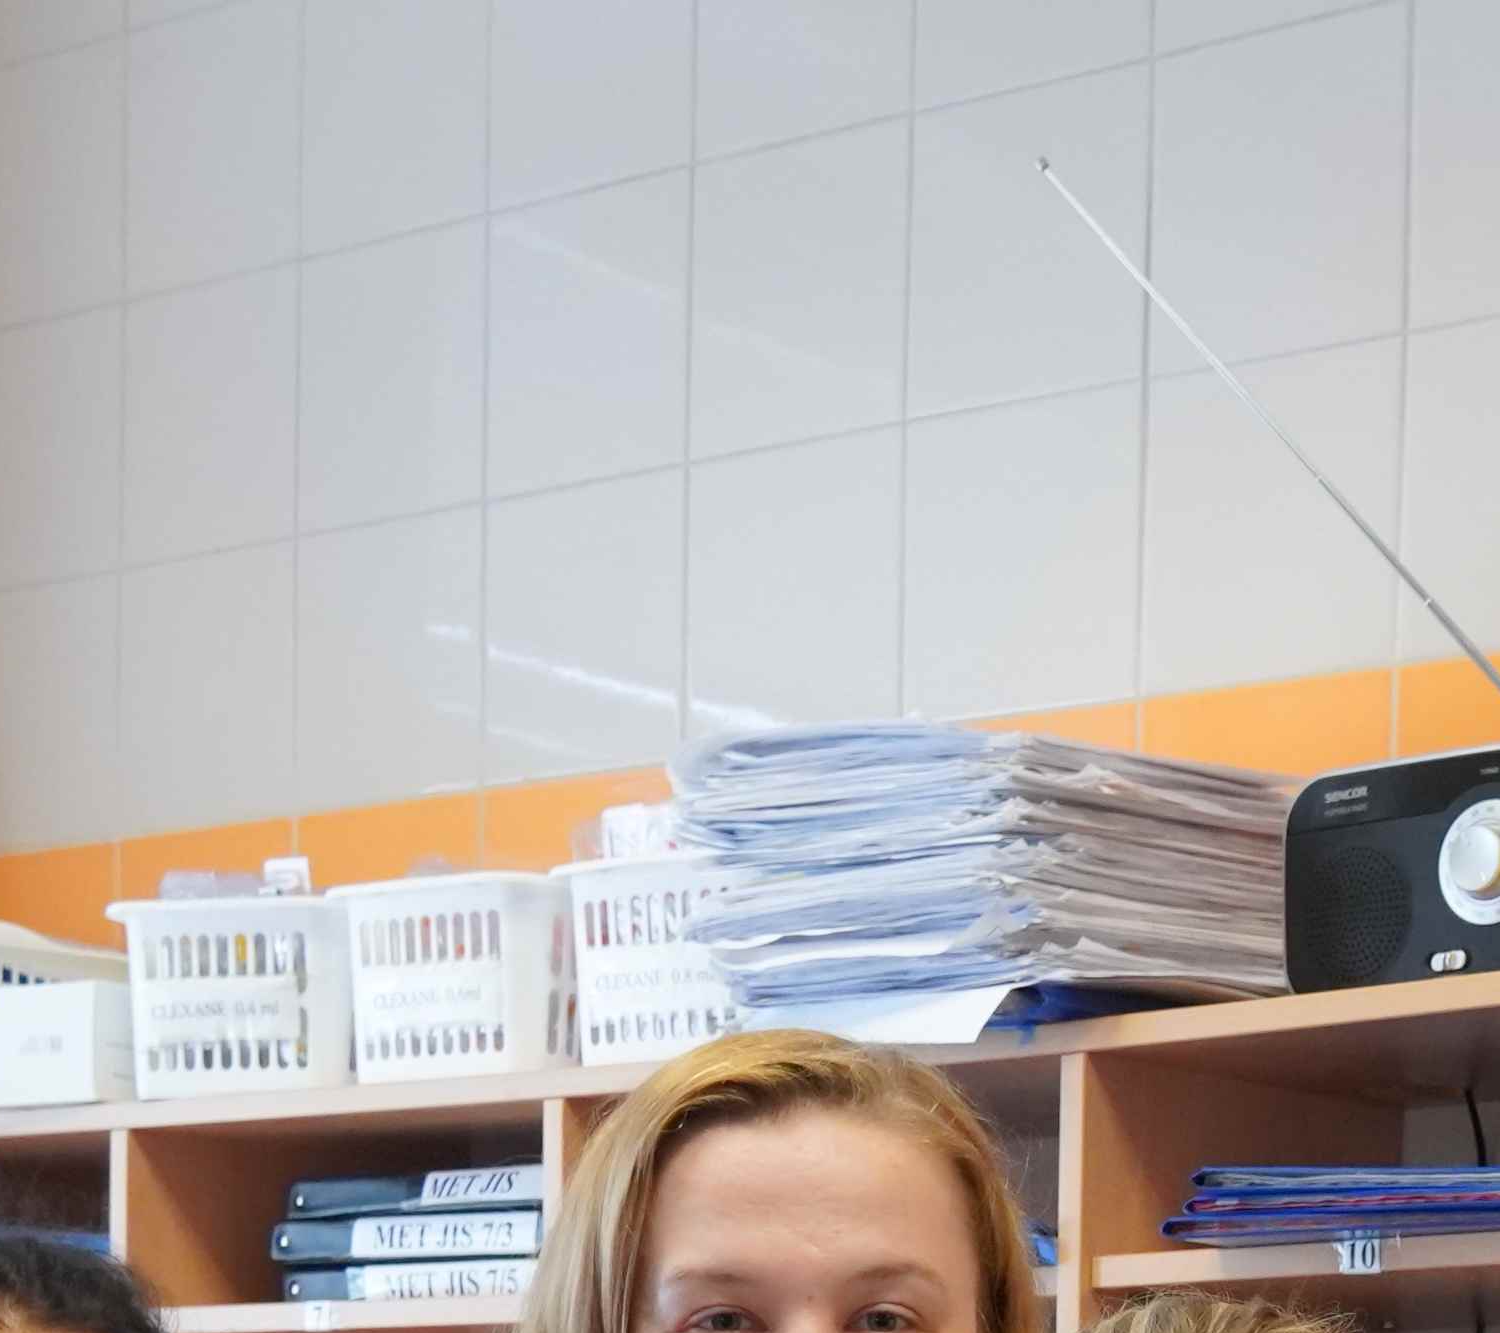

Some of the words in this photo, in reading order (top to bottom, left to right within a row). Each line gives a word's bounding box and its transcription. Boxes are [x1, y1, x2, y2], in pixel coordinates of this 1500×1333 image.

[430, 1175, 476, 1198] MET
[479, 1171, 521, 1194] JIS
[373, 1223, 427, 1249] MET
[436, 1222, 476, 1249] JIS
[483, 1221, 514, 1248] 7/3
[1349, 1240, 1376, 1269] 10
[386, 1273, 437, 1300] MET
[445, 1271, 481, 1296] JIS
[487, 1269, 518, 1296] 7/5
